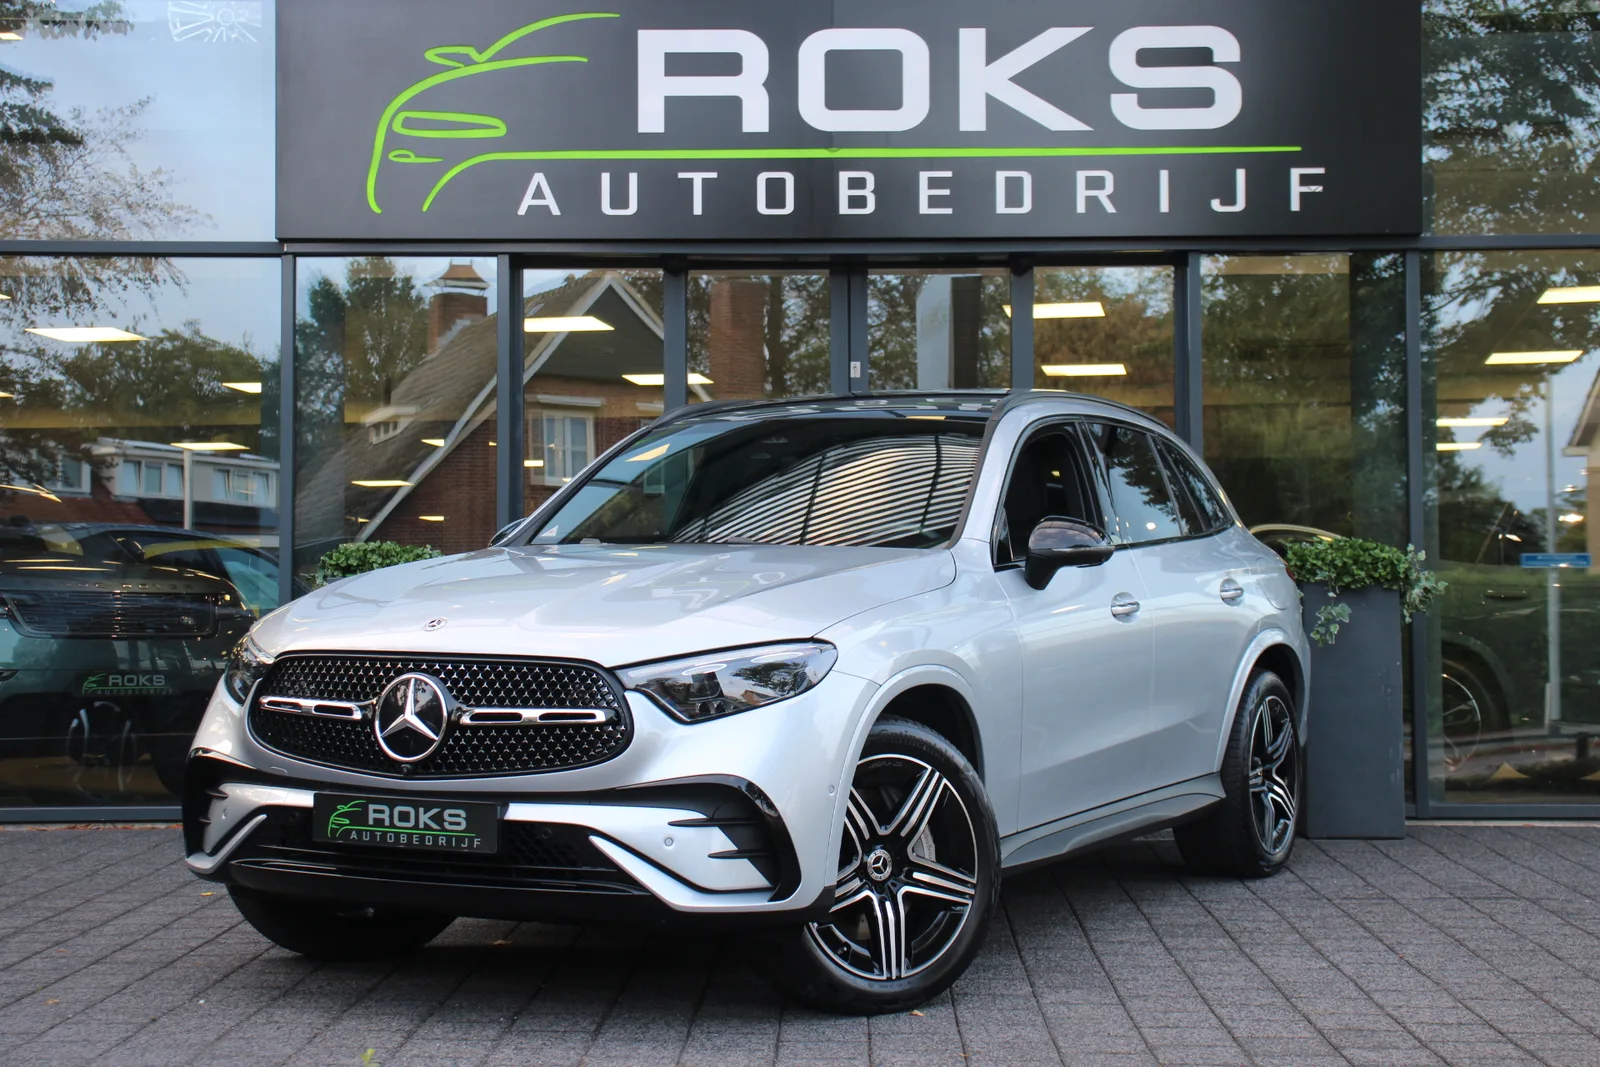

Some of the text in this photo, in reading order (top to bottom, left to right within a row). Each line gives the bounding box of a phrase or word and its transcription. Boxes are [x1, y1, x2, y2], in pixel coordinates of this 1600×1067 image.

[637, 26, 1242, 134] ROKS
[517, 167, 1325, 216] AUTOBEDRIJF
[108, 675, 166, 686] ROKS
[367, 803, 468, 831] ROKS
[349, 829, 482, 849] AUTOBEDRIJF
